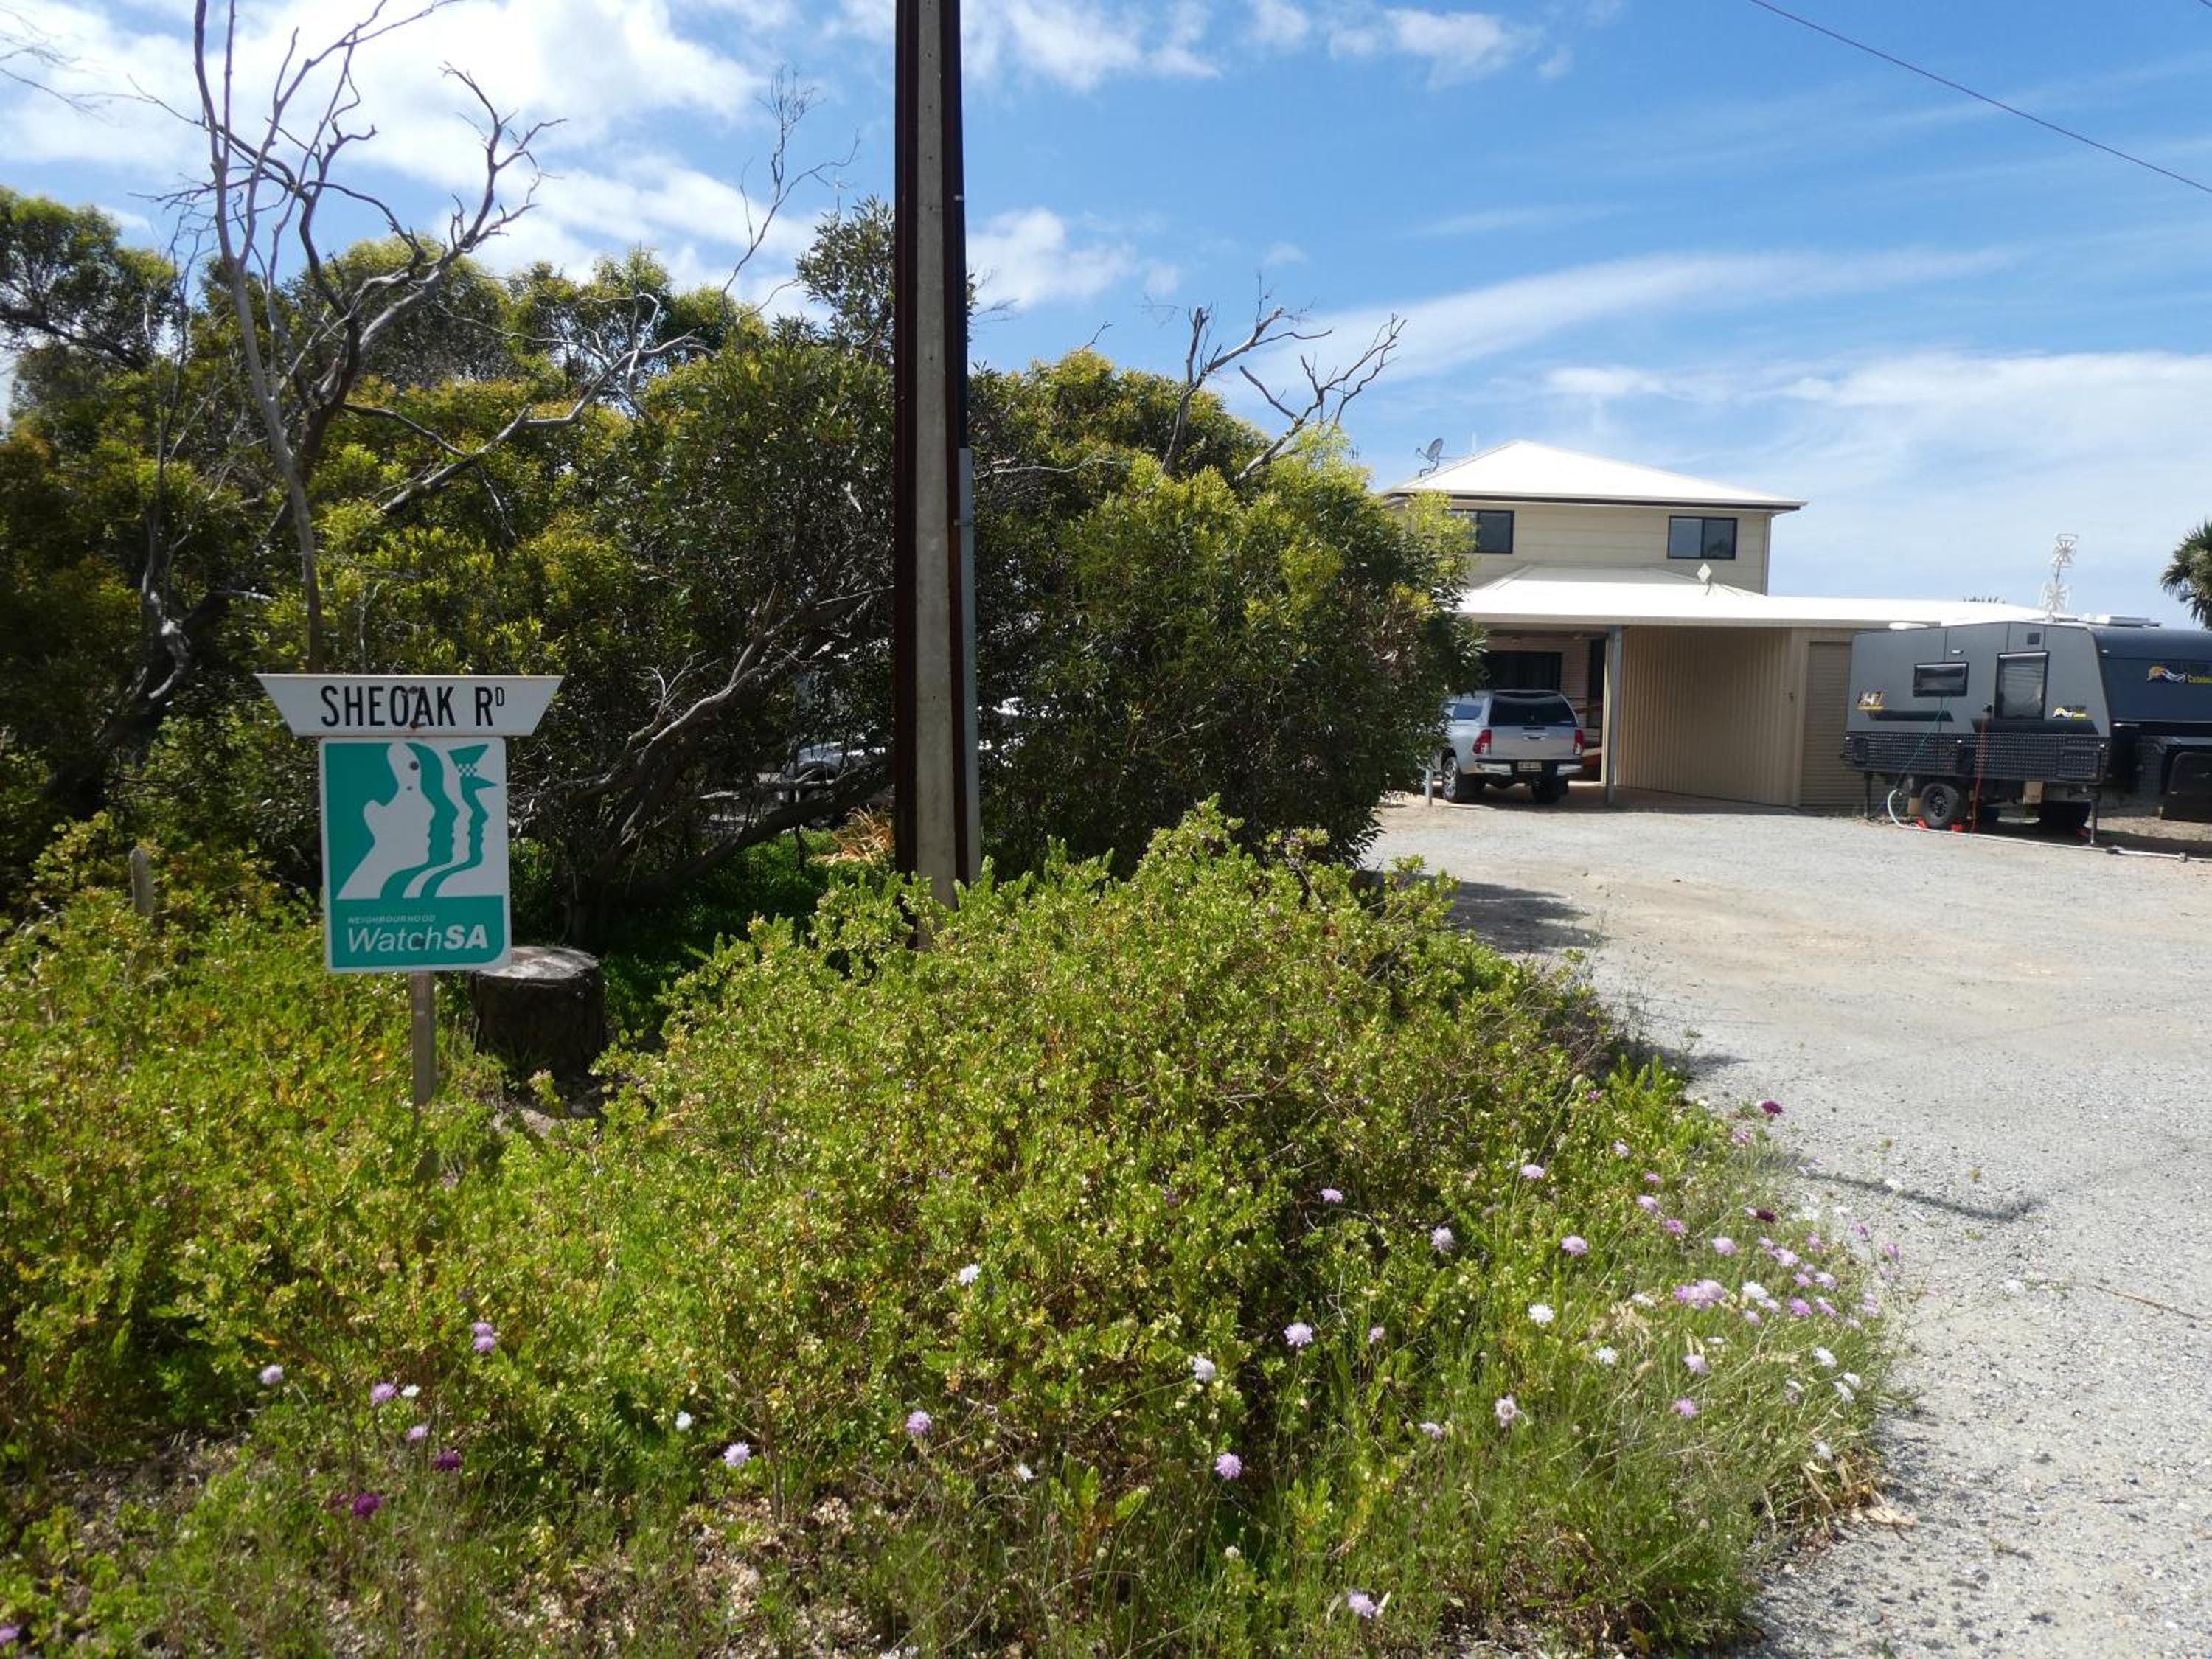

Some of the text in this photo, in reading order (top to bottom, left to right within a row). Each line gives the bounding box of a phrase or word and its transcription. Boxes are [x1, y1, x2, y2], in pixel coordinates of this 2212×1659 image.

[321, 685, 505, 727] SHEOAK RD
[348, 914, 436, 924] NEIGHBOURHOOD
[348, 923, 488, 953] WatchSA
